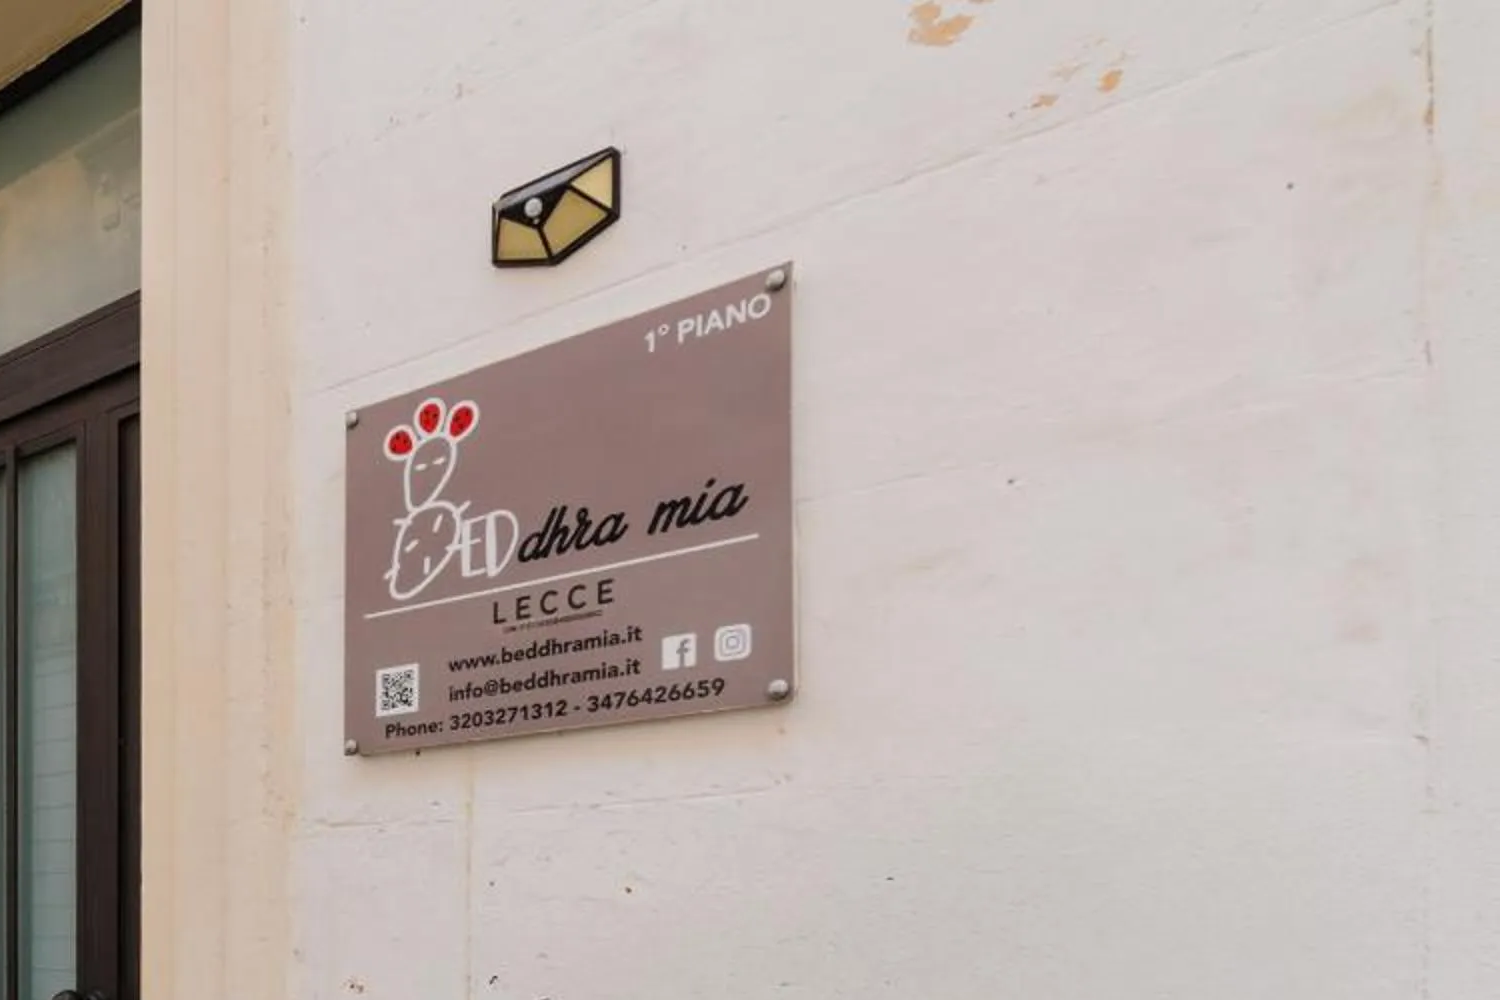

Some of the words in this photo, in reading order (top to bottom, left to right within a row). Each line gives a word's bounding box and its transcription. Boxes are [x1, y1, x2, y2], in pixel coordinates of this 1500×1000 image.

[644, 323, 670, 353] 1°
[677, 293, 772, 344] PIANO
[647, 477, 749, 535] mia
[492, 578, 615, 625] LECCE
[448, 625, 644, 673] www.beddhramia.it
[448, 658, 641, 703] info@beddhramia.it
[385, 720, 444, 739] Phone:
[449, 699, 568, 731] 3203271312
[587, 677, 726, 713] 3476426659
